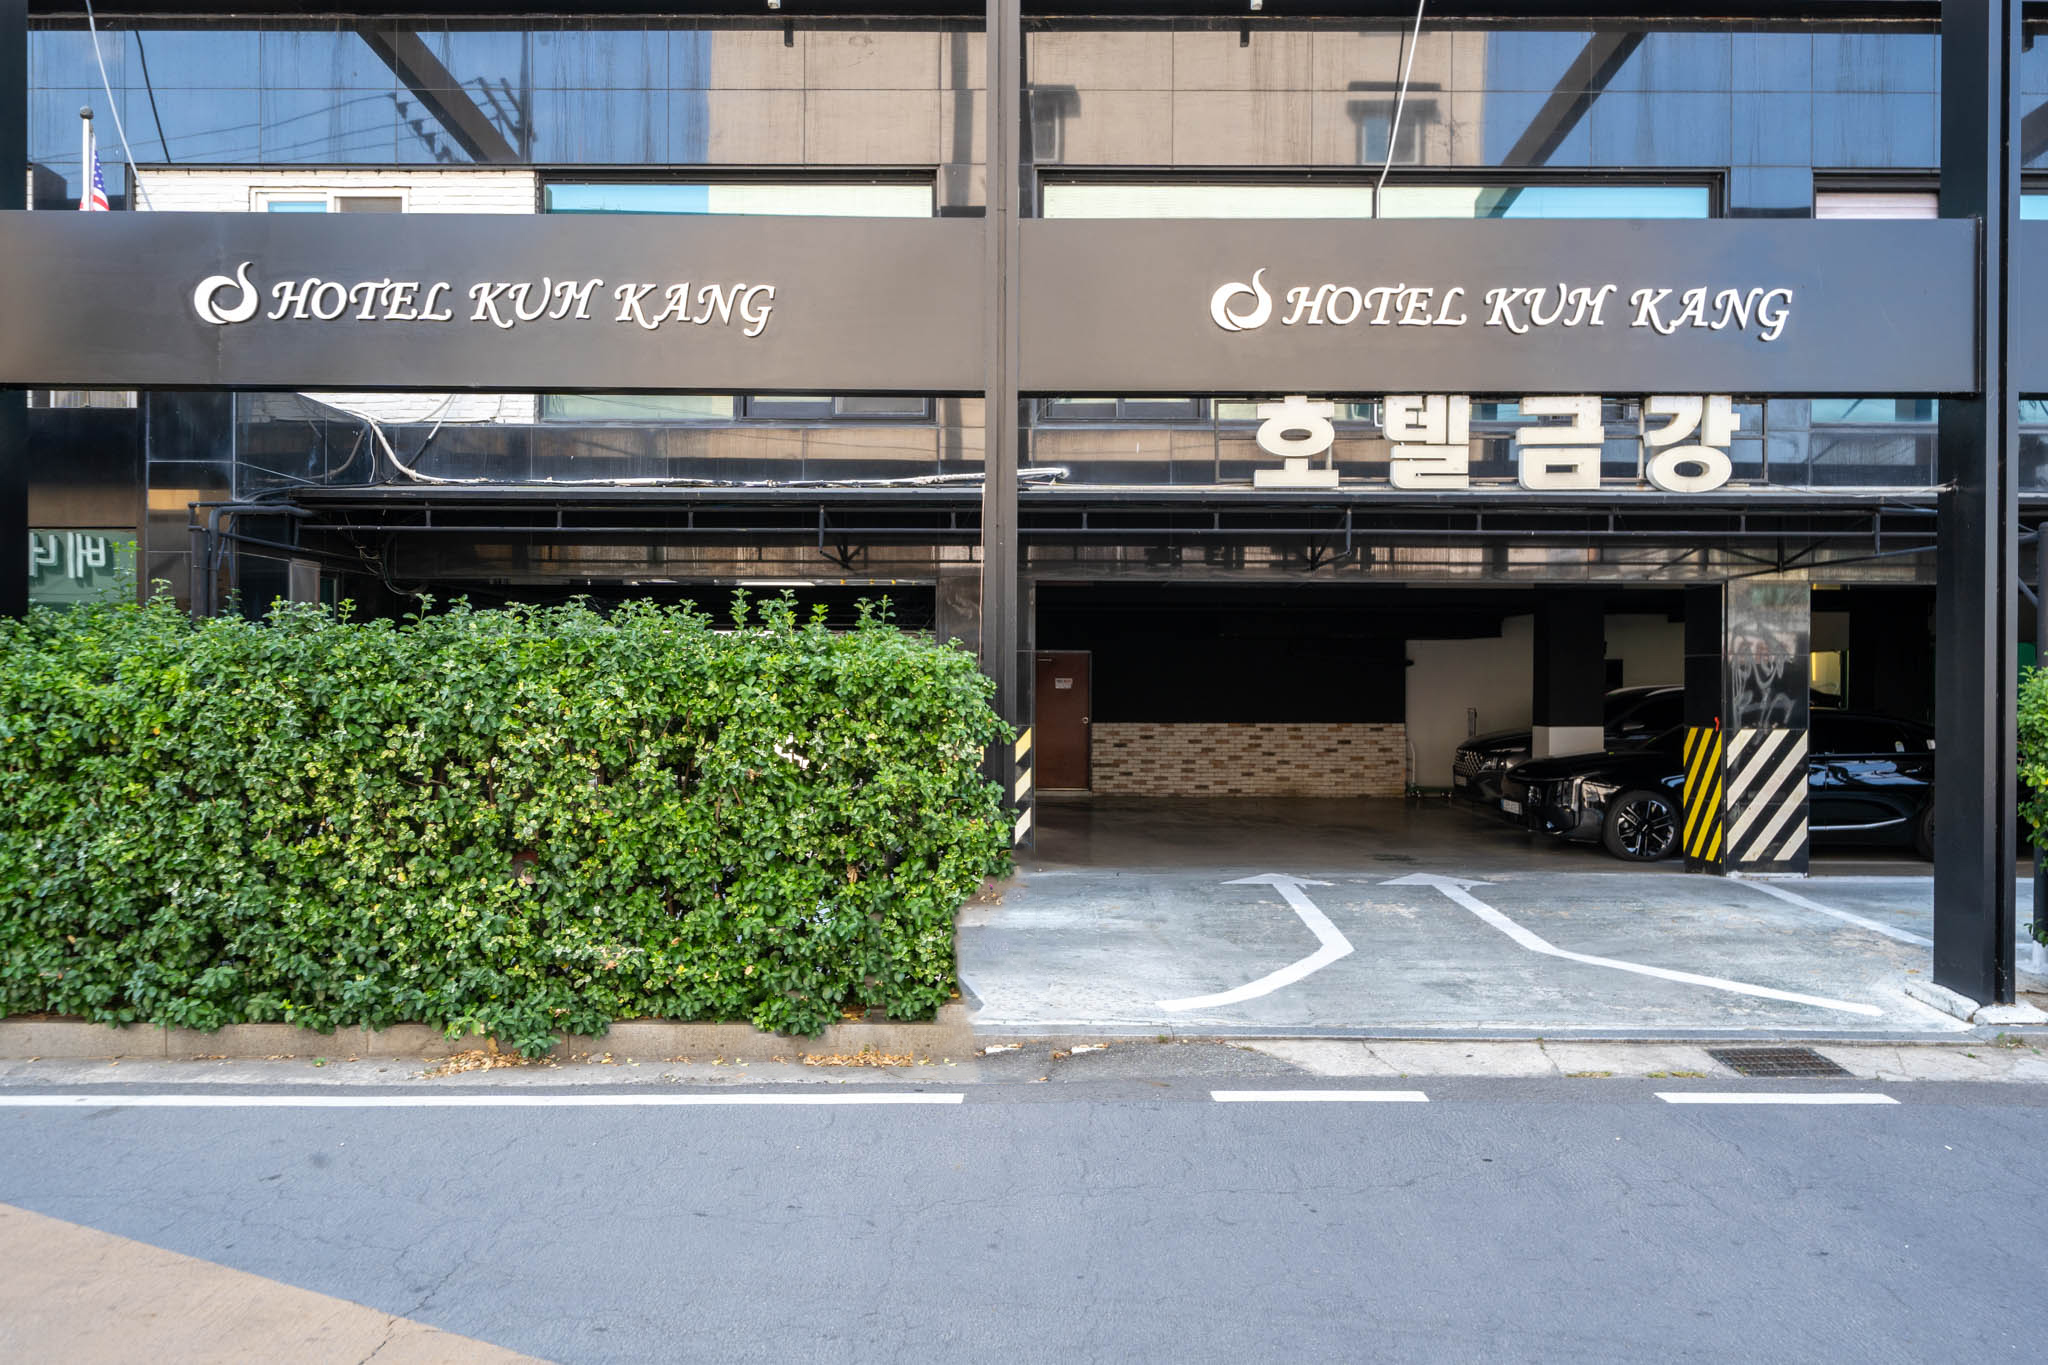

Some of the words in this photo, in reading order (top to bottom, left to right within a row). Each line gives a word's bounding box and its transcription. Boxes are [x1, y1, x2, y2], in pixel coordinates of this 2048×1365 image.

[266, 277, 453, 326] HOTEL
[467, 276, 604, 331] KUM
[613, 281, 777, 338] KANG
[1281, 282, 1468, 327] HOTEL
[1484, 281, 1618, 335] KUM
[1629, 285, 1794, 342] KANG
